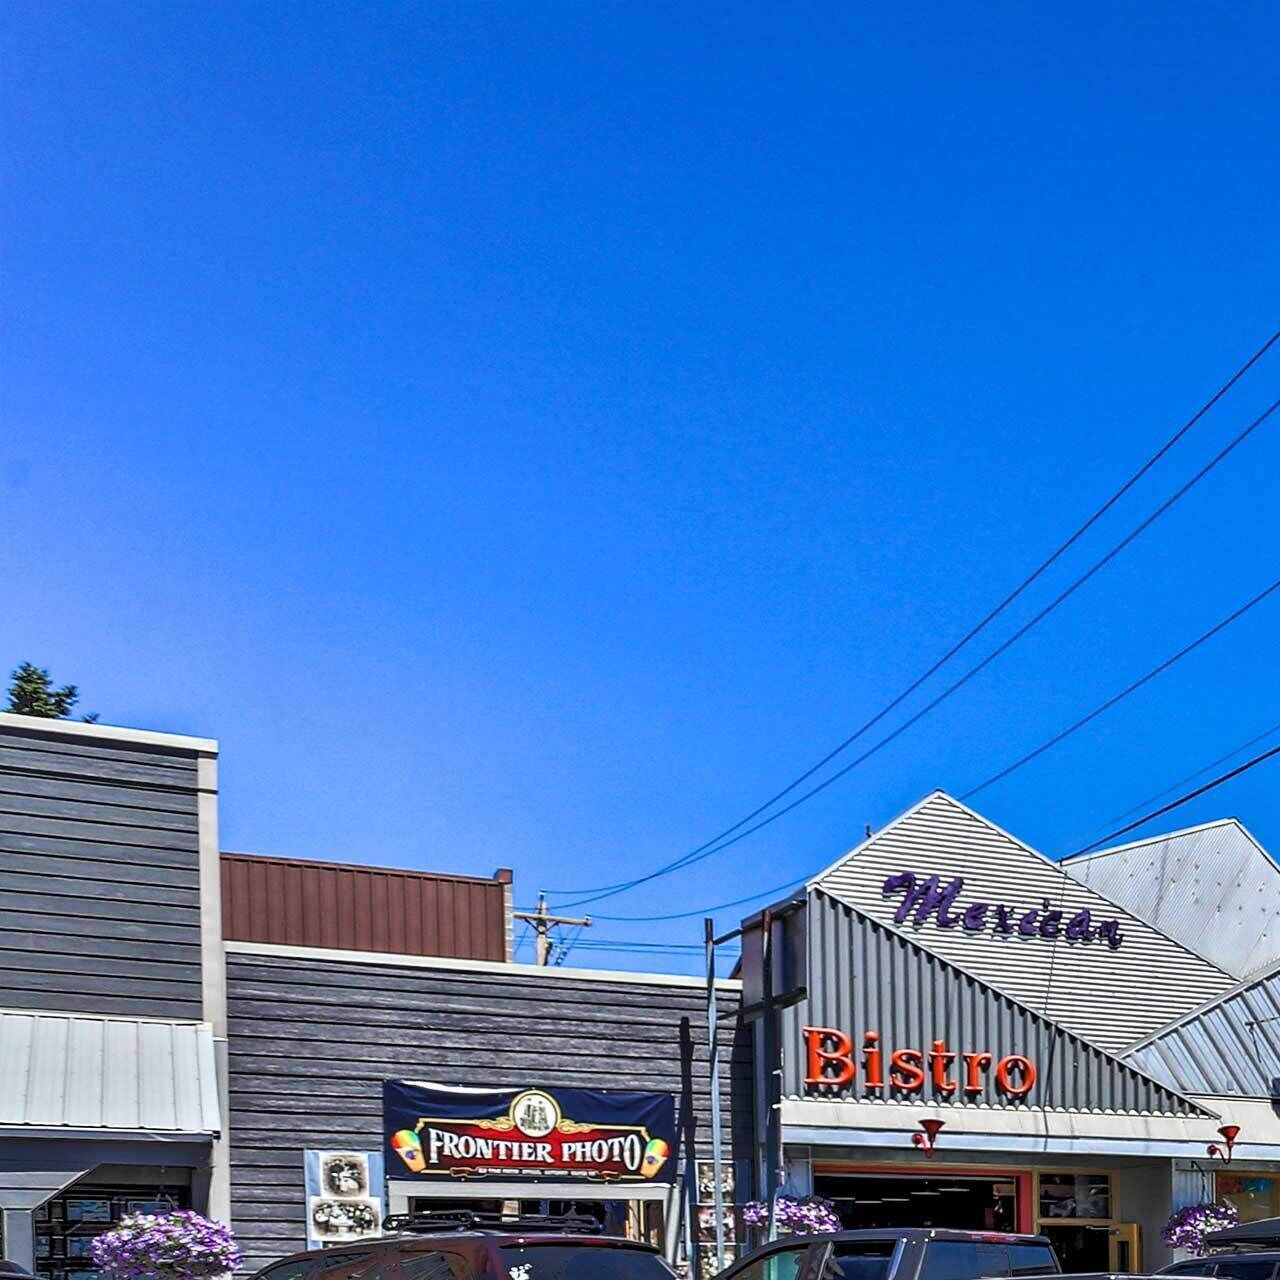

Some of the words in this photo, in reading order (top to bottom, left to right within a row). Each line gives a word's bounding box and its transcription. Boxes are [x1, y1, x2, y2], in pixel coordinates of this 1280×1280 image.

[882, 872, 1123, 947] Mexican
[803, 1025, 1037, 1097] Bistro
[428, 1127, 554, 1164] FRONTIER
[562, 1133, 642, 1171] PHOTO
